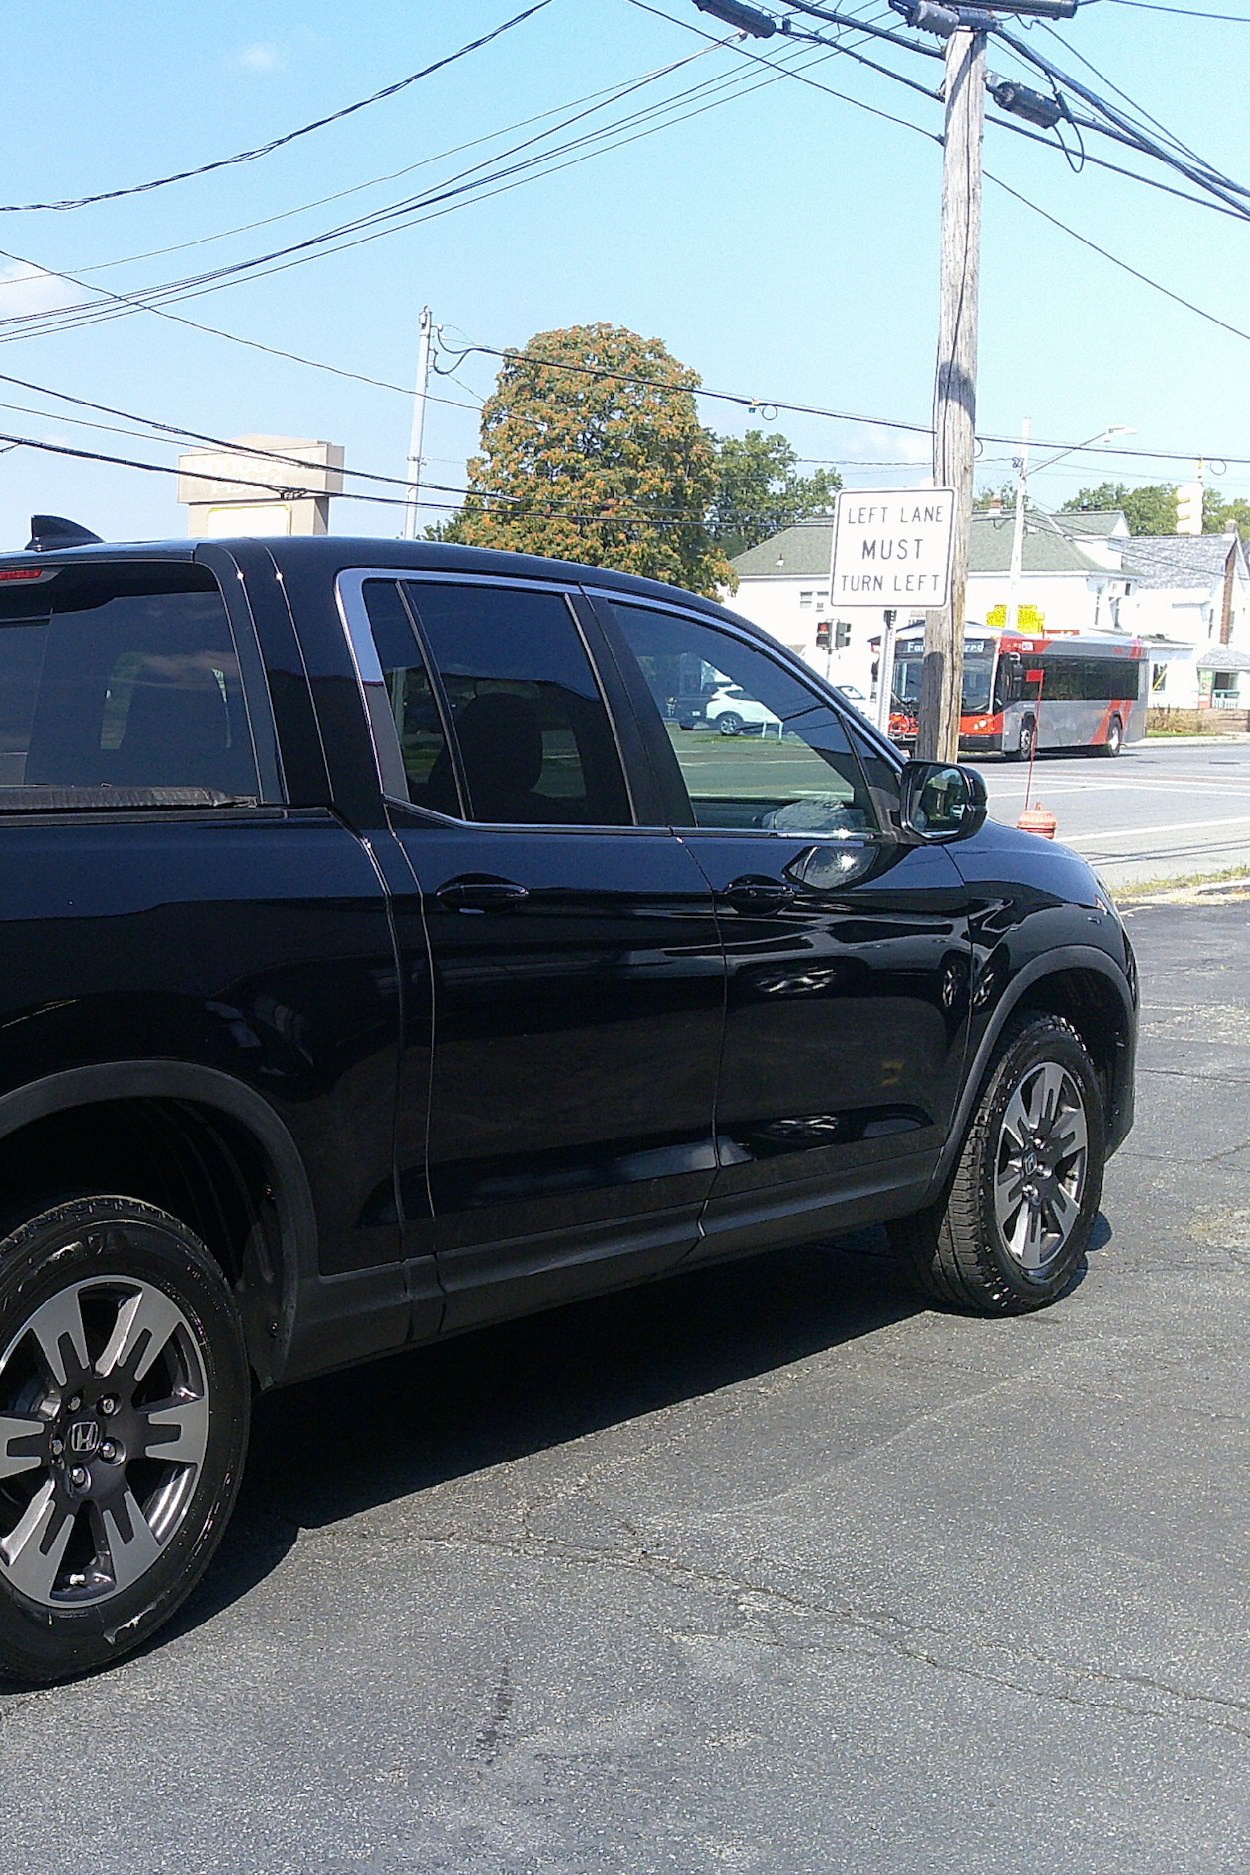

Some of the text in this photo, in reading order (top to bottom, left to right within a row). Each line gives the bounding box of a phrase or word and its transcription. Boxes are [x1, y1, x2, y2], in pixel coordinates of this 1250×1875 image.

[848, 505, 944, 524] LEFT LANE
[861, 538, 924, 560] MUST
[841, 574, 940, 592] TURN LEFT
